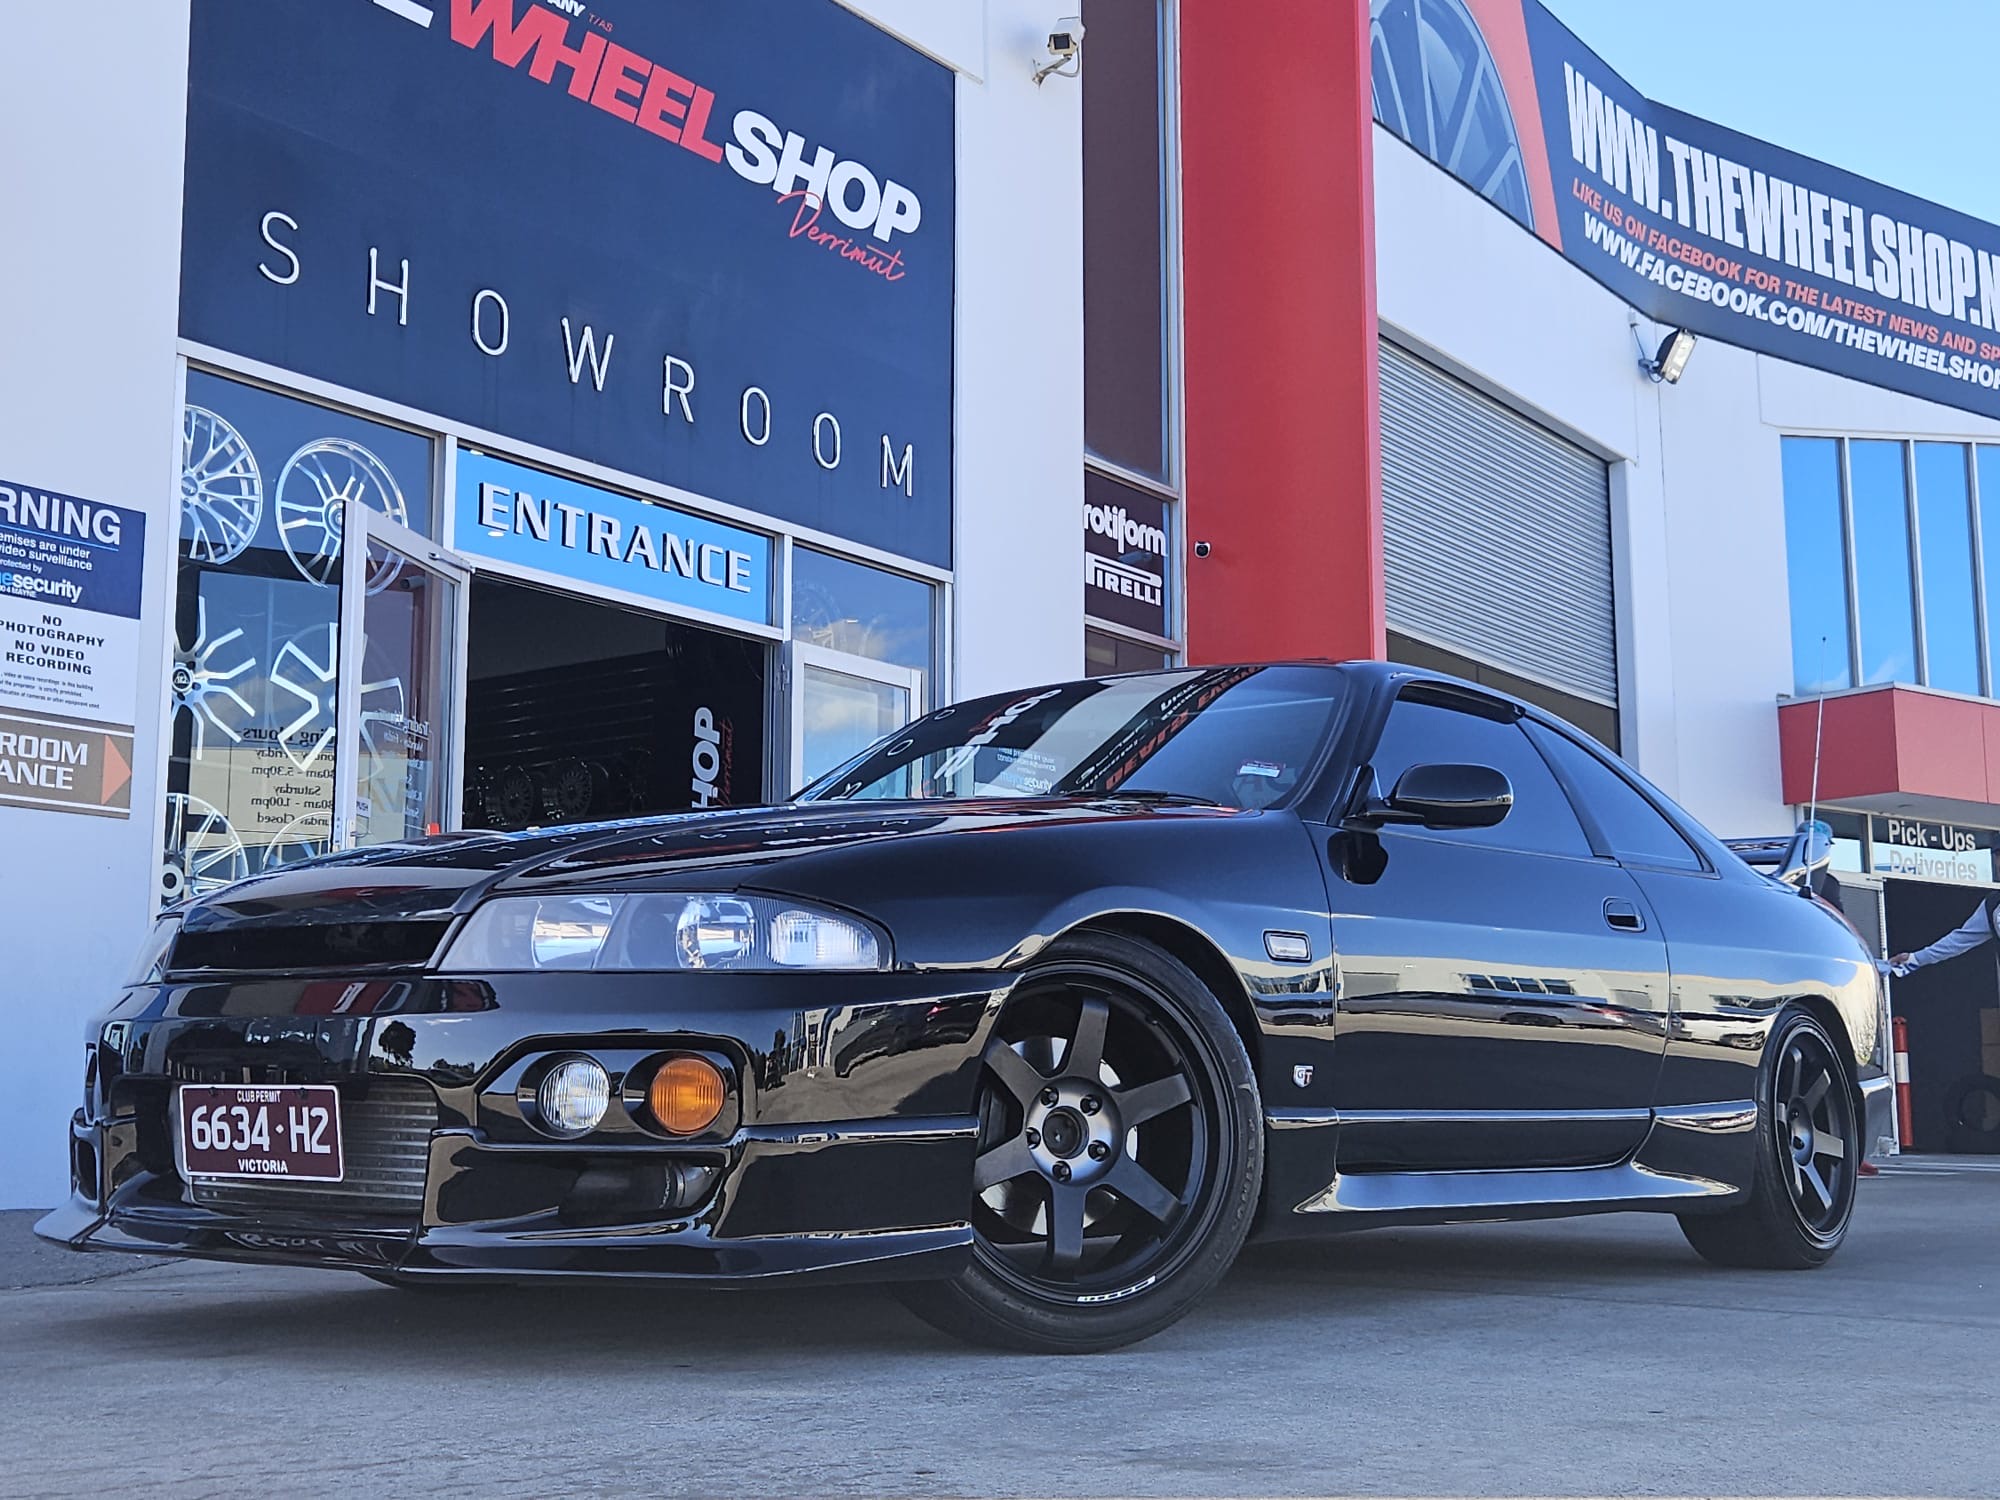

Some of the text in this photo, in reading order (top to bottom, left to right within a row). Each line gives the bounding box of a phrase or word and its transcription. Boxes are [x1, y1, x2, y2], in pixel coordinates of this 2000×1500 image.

[725, 110, 921, 243] SHOP
[1572, 177, 2000, 363] LIKE US ON FACEBOOK FOR THE LATEST NEWS AND SP
[39, 540, 57, 552] are
[60, 544, 91, 559] under
[479, 481, 752, 594] ENTRANCE
[28, 550, 93, 571] surveillance
[32, 562, 42, 574] by
[0, 571, 82, 604] esecurity
[1085, 551, 1163, 606] PIRELLI
[42, 614, 62, 627] NO
[14, 639, 85, 661] NO VIDEO
[6, 651, 92, 675] RECORDING
[1888, 819, 1927, 847] Pick
[1941, 825, 1976, 856] Ups
[1890, 850, 1978, 881] Deliveries
[236, 1090, 281, 1103] CLUB PERMIT
[237, 1158, 288, 1174] VICTORIA
